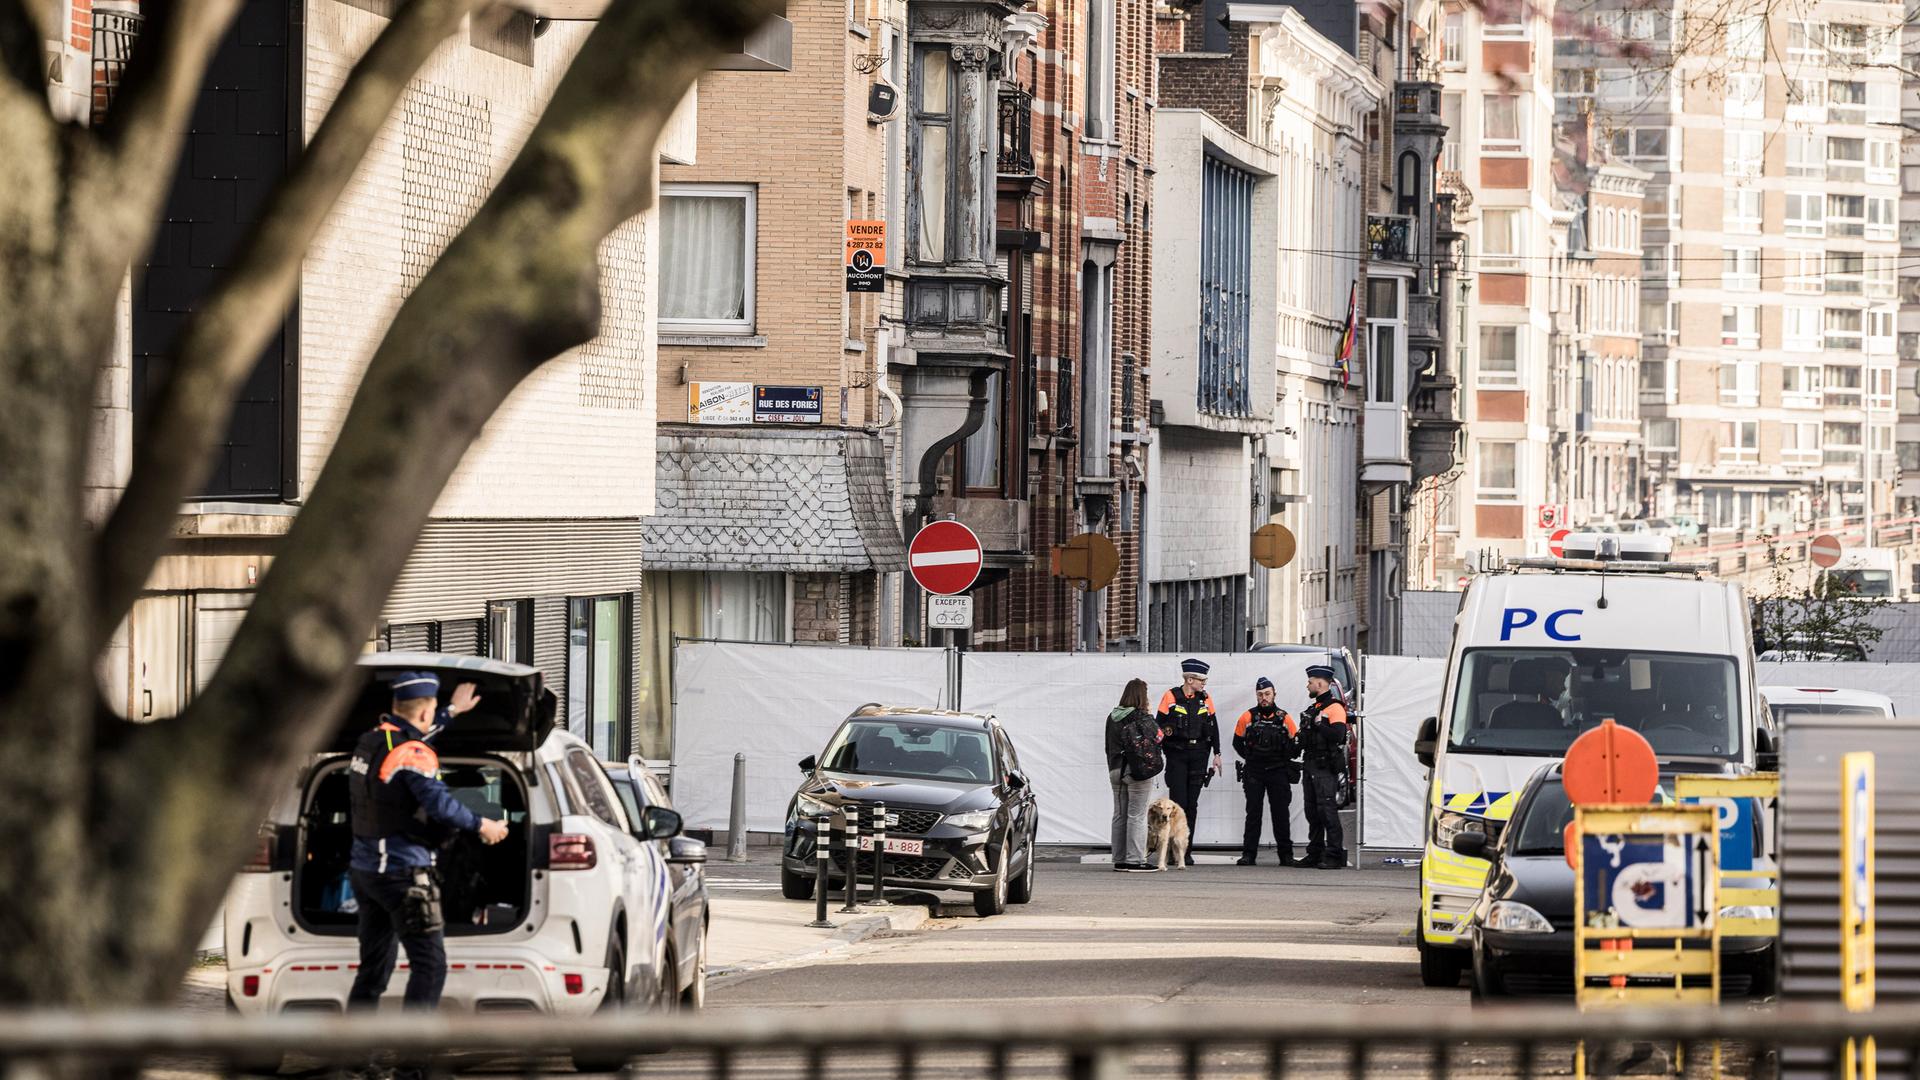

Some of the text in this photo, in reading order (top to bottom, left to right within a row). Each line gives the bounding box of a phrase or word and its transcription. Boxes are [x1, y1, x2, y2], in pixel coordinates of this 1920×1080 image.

[851, 225, 883, 234] VENDRE
[852, 241, 865, 249] 287
[690, 393, 726, 413] MAISON
[759, 400, 818, 409] RUE DES FORIES
[1500, 608, 1584, 641] PC
[862, 838, 920, 853] 2-A-882
